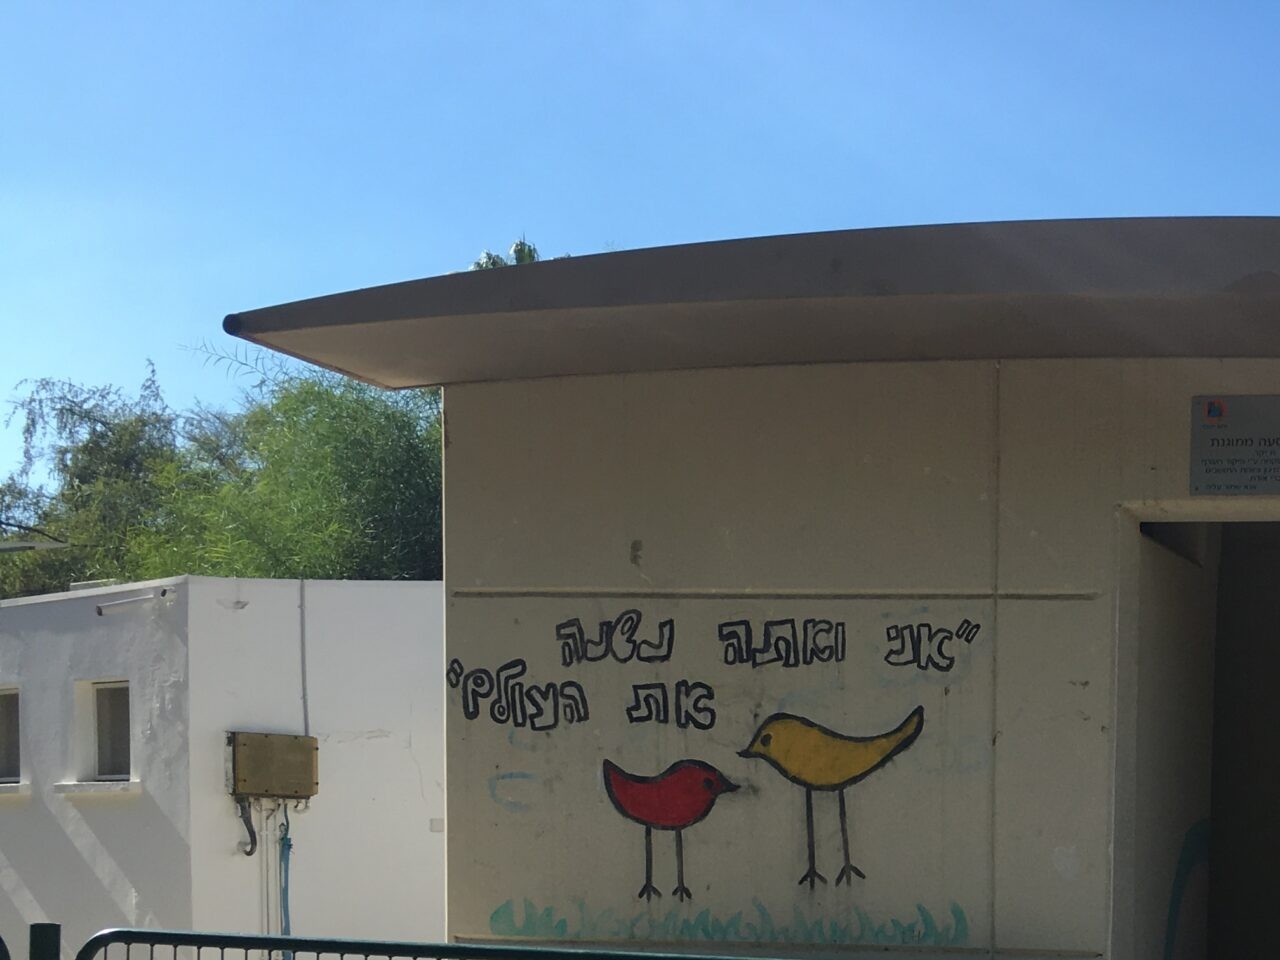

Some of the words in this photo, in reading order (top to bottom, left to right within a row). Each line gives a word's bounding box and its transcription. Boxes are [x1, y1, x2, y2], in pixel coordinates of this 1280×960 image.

[1210, 437, 1254, 448] ממוגנת
[555, 609, 674, 667] נשנה
[719, 617, 847, 668] ואתה
[626, 681, 717, 730] את
